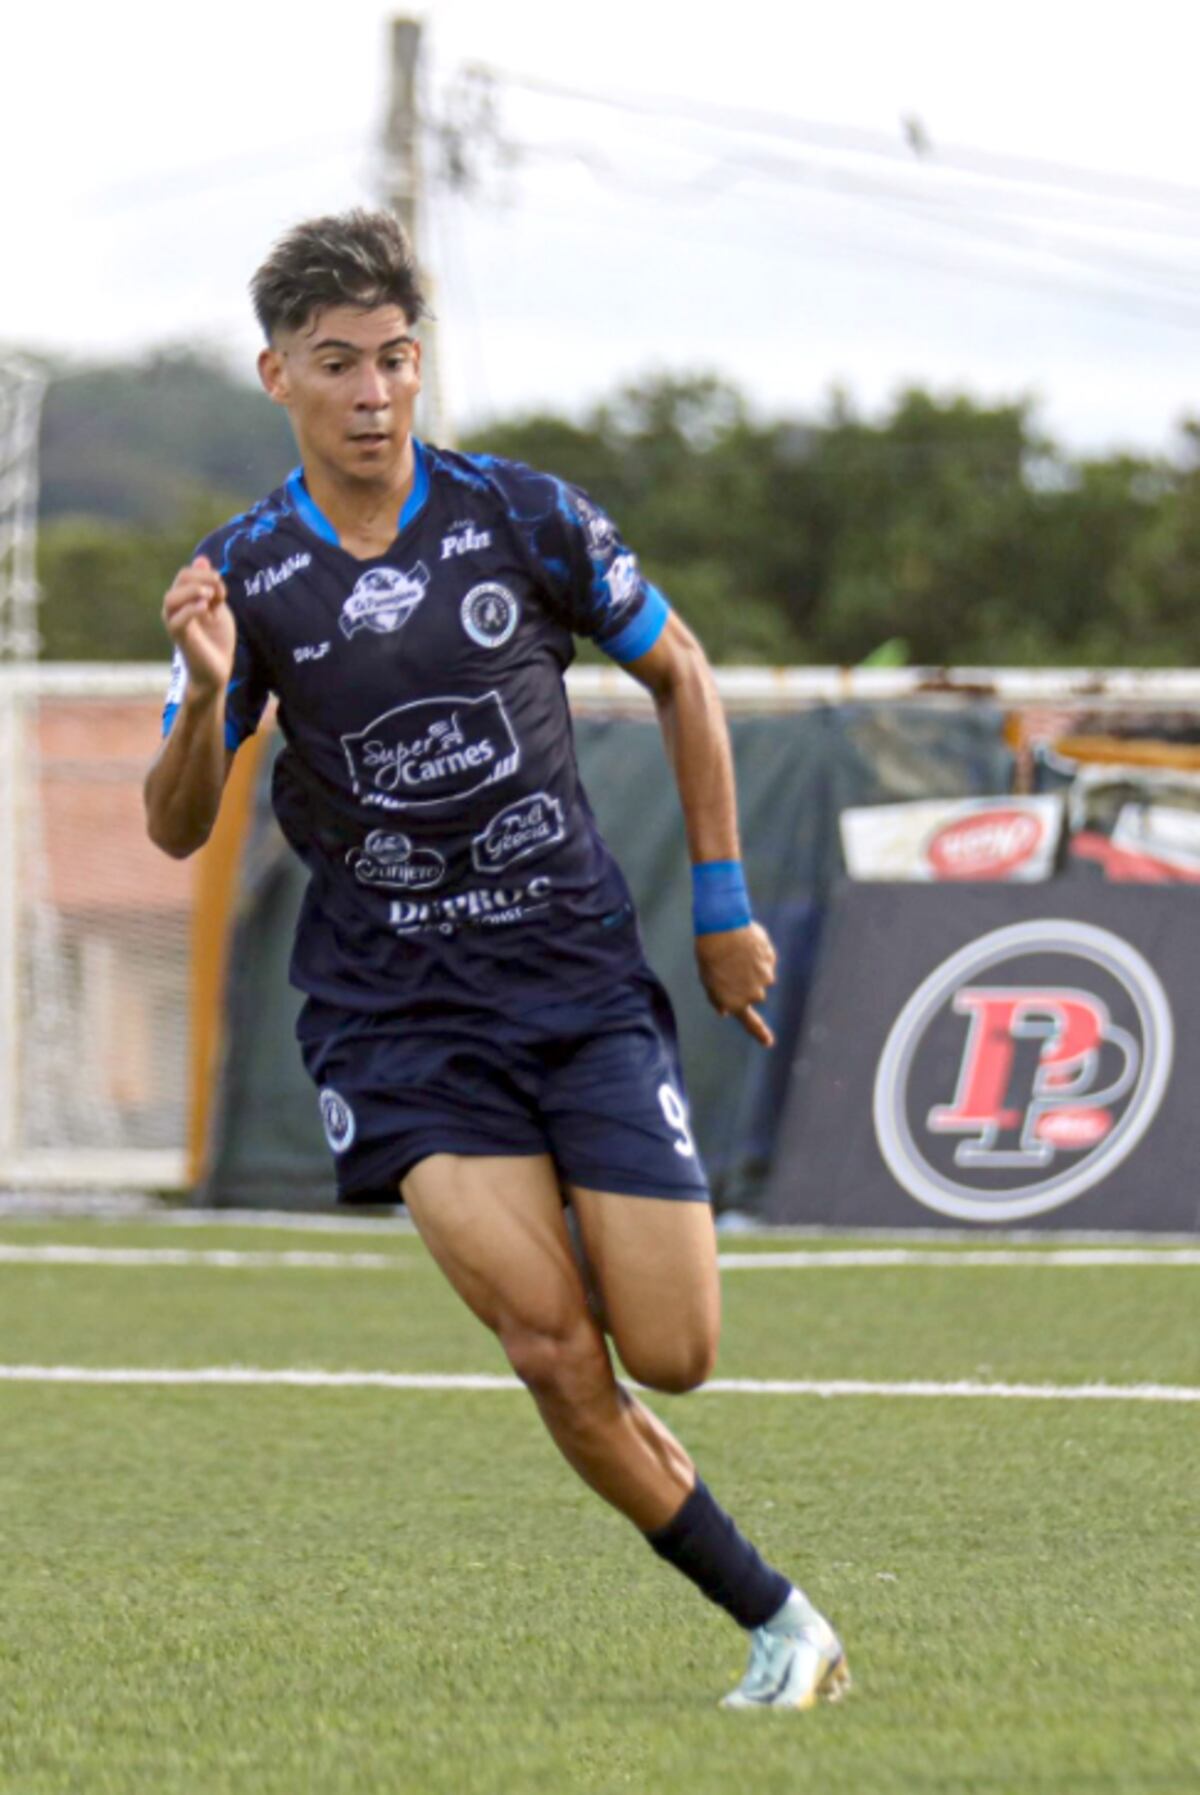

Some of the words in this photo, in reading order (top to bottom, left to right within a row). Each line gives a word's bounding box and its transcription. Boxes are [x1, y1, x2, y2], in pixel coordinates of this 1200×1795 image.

[362, 737, 434, 791] Super
[402, 738, 494, 786] Carnes
[657, 1084, 695, 1156] 9
